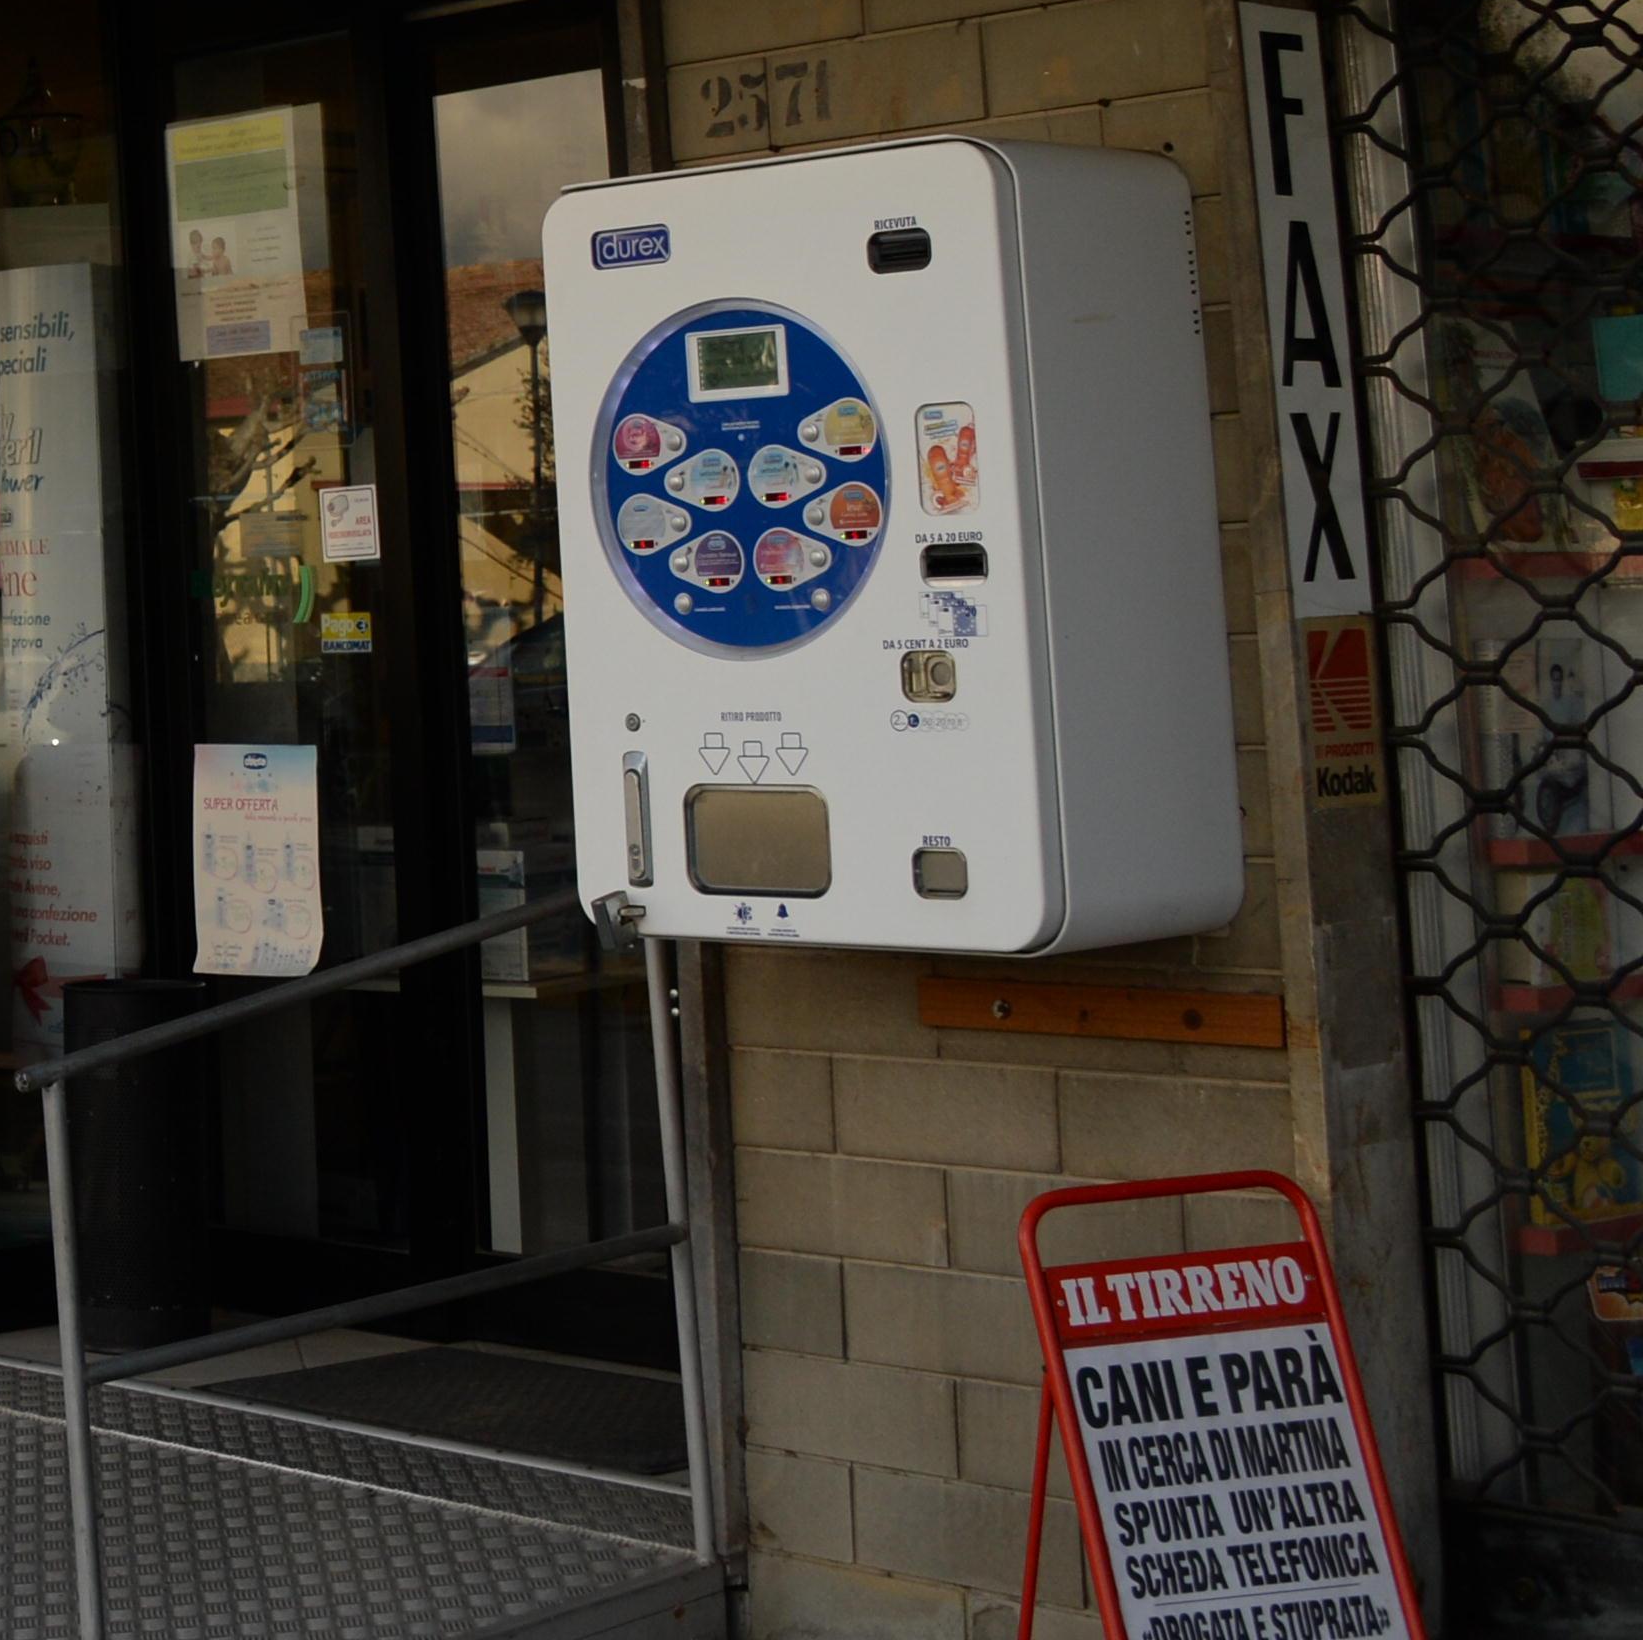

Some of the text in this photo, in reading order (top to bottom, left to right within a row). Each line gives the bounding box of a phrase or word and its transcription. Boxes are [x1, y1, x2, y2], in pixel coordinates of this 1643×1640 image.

[699, 61, 832, 138] 2571
[874, 216, 917, 230] RICEVUTA
[601, 232, 667, 261] durex
[1259, 30, 1356, 582] FAX
[0, 311, 75, 342] sensibili,
[355, 516, 371, 526] AREA
[915, 531, 983, 544] DA 5 A 20 EURO
[322, 616, 354, 638] Pago
[322, 640, 372, 652] BANCOMAT
[883, 638, 969, 650] DA 5 CENT A 2 EURO
[721, 710, 782, 723] RITIRO PRODOTTO
[1316, 764, 1377, 797] Kodak
[203, 797, 278, 811] SUPER OFFERTA
[922, 835, 951, 847] RESTO
[30, 857, 52, 872] viso
[30, 904, 97, 923] confezione
[1061, 1256, 1306, 1326] IL TIRRENO
[1076, 1329, 1343, 1430] CANI E PARÀ
[1098, 1416, 1351, 1493] IN CERCA DI MARTINA
[1114, 1479, 1366, 1546] SPUNTA UN'ALTRA
[1126, 1531, 1379, 1599] SCHEDA TELEFONICA
[1251, 1605, 1269, 1640] E
